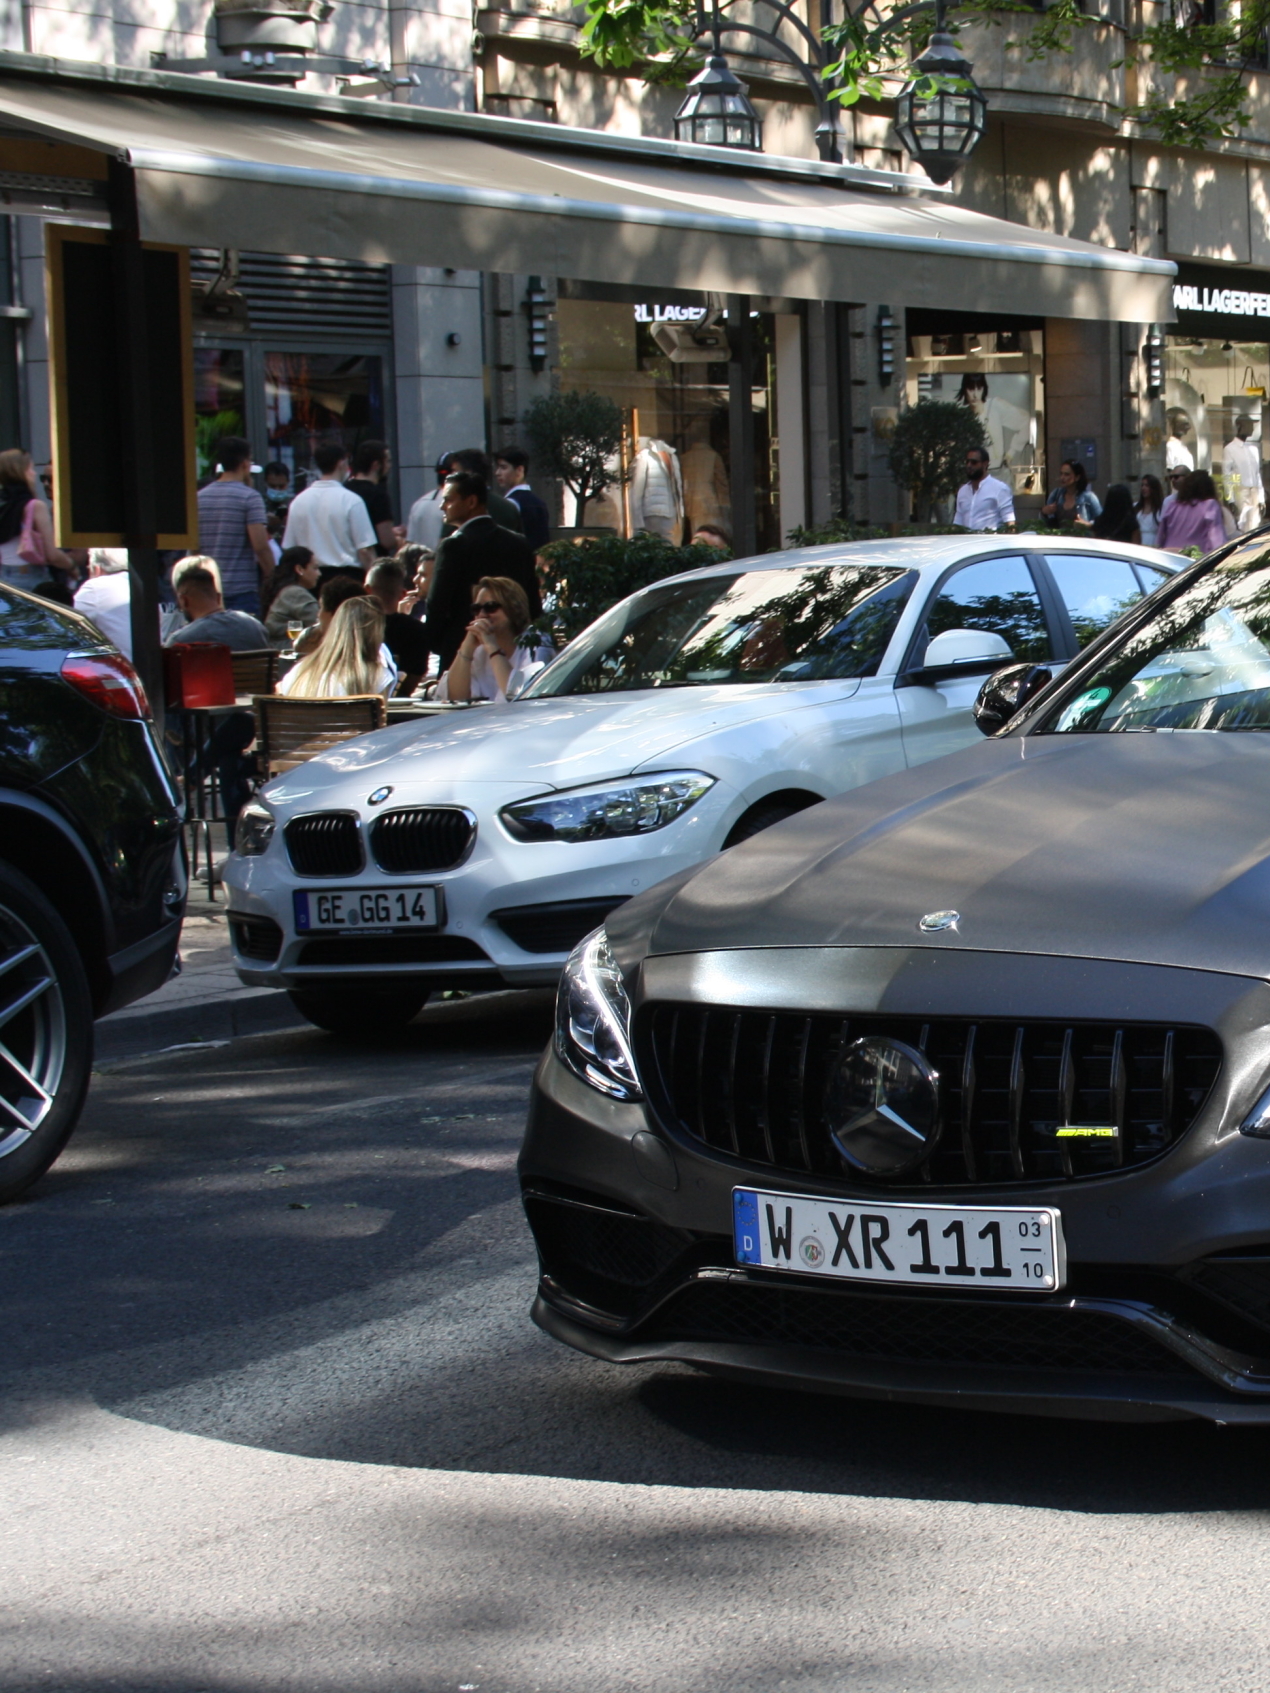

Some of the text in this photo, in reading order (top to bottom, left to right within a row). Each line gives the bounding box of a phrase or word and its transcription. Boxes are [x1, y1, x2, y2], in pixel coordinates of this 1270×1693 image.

[1172, 285, 1202, 311] ARL
[317, 895, 345, 924] GE
[360, 893, 390, 923] GG
[395, 892, 426, 922] 14
[1074, 1128, 1113, 1137] AMG
[1018, 1221, 1041, 1237] 03
[743, 1203, 1012, 1278] D W XR 111
[1022, 1262, 1043, 1278] 10
